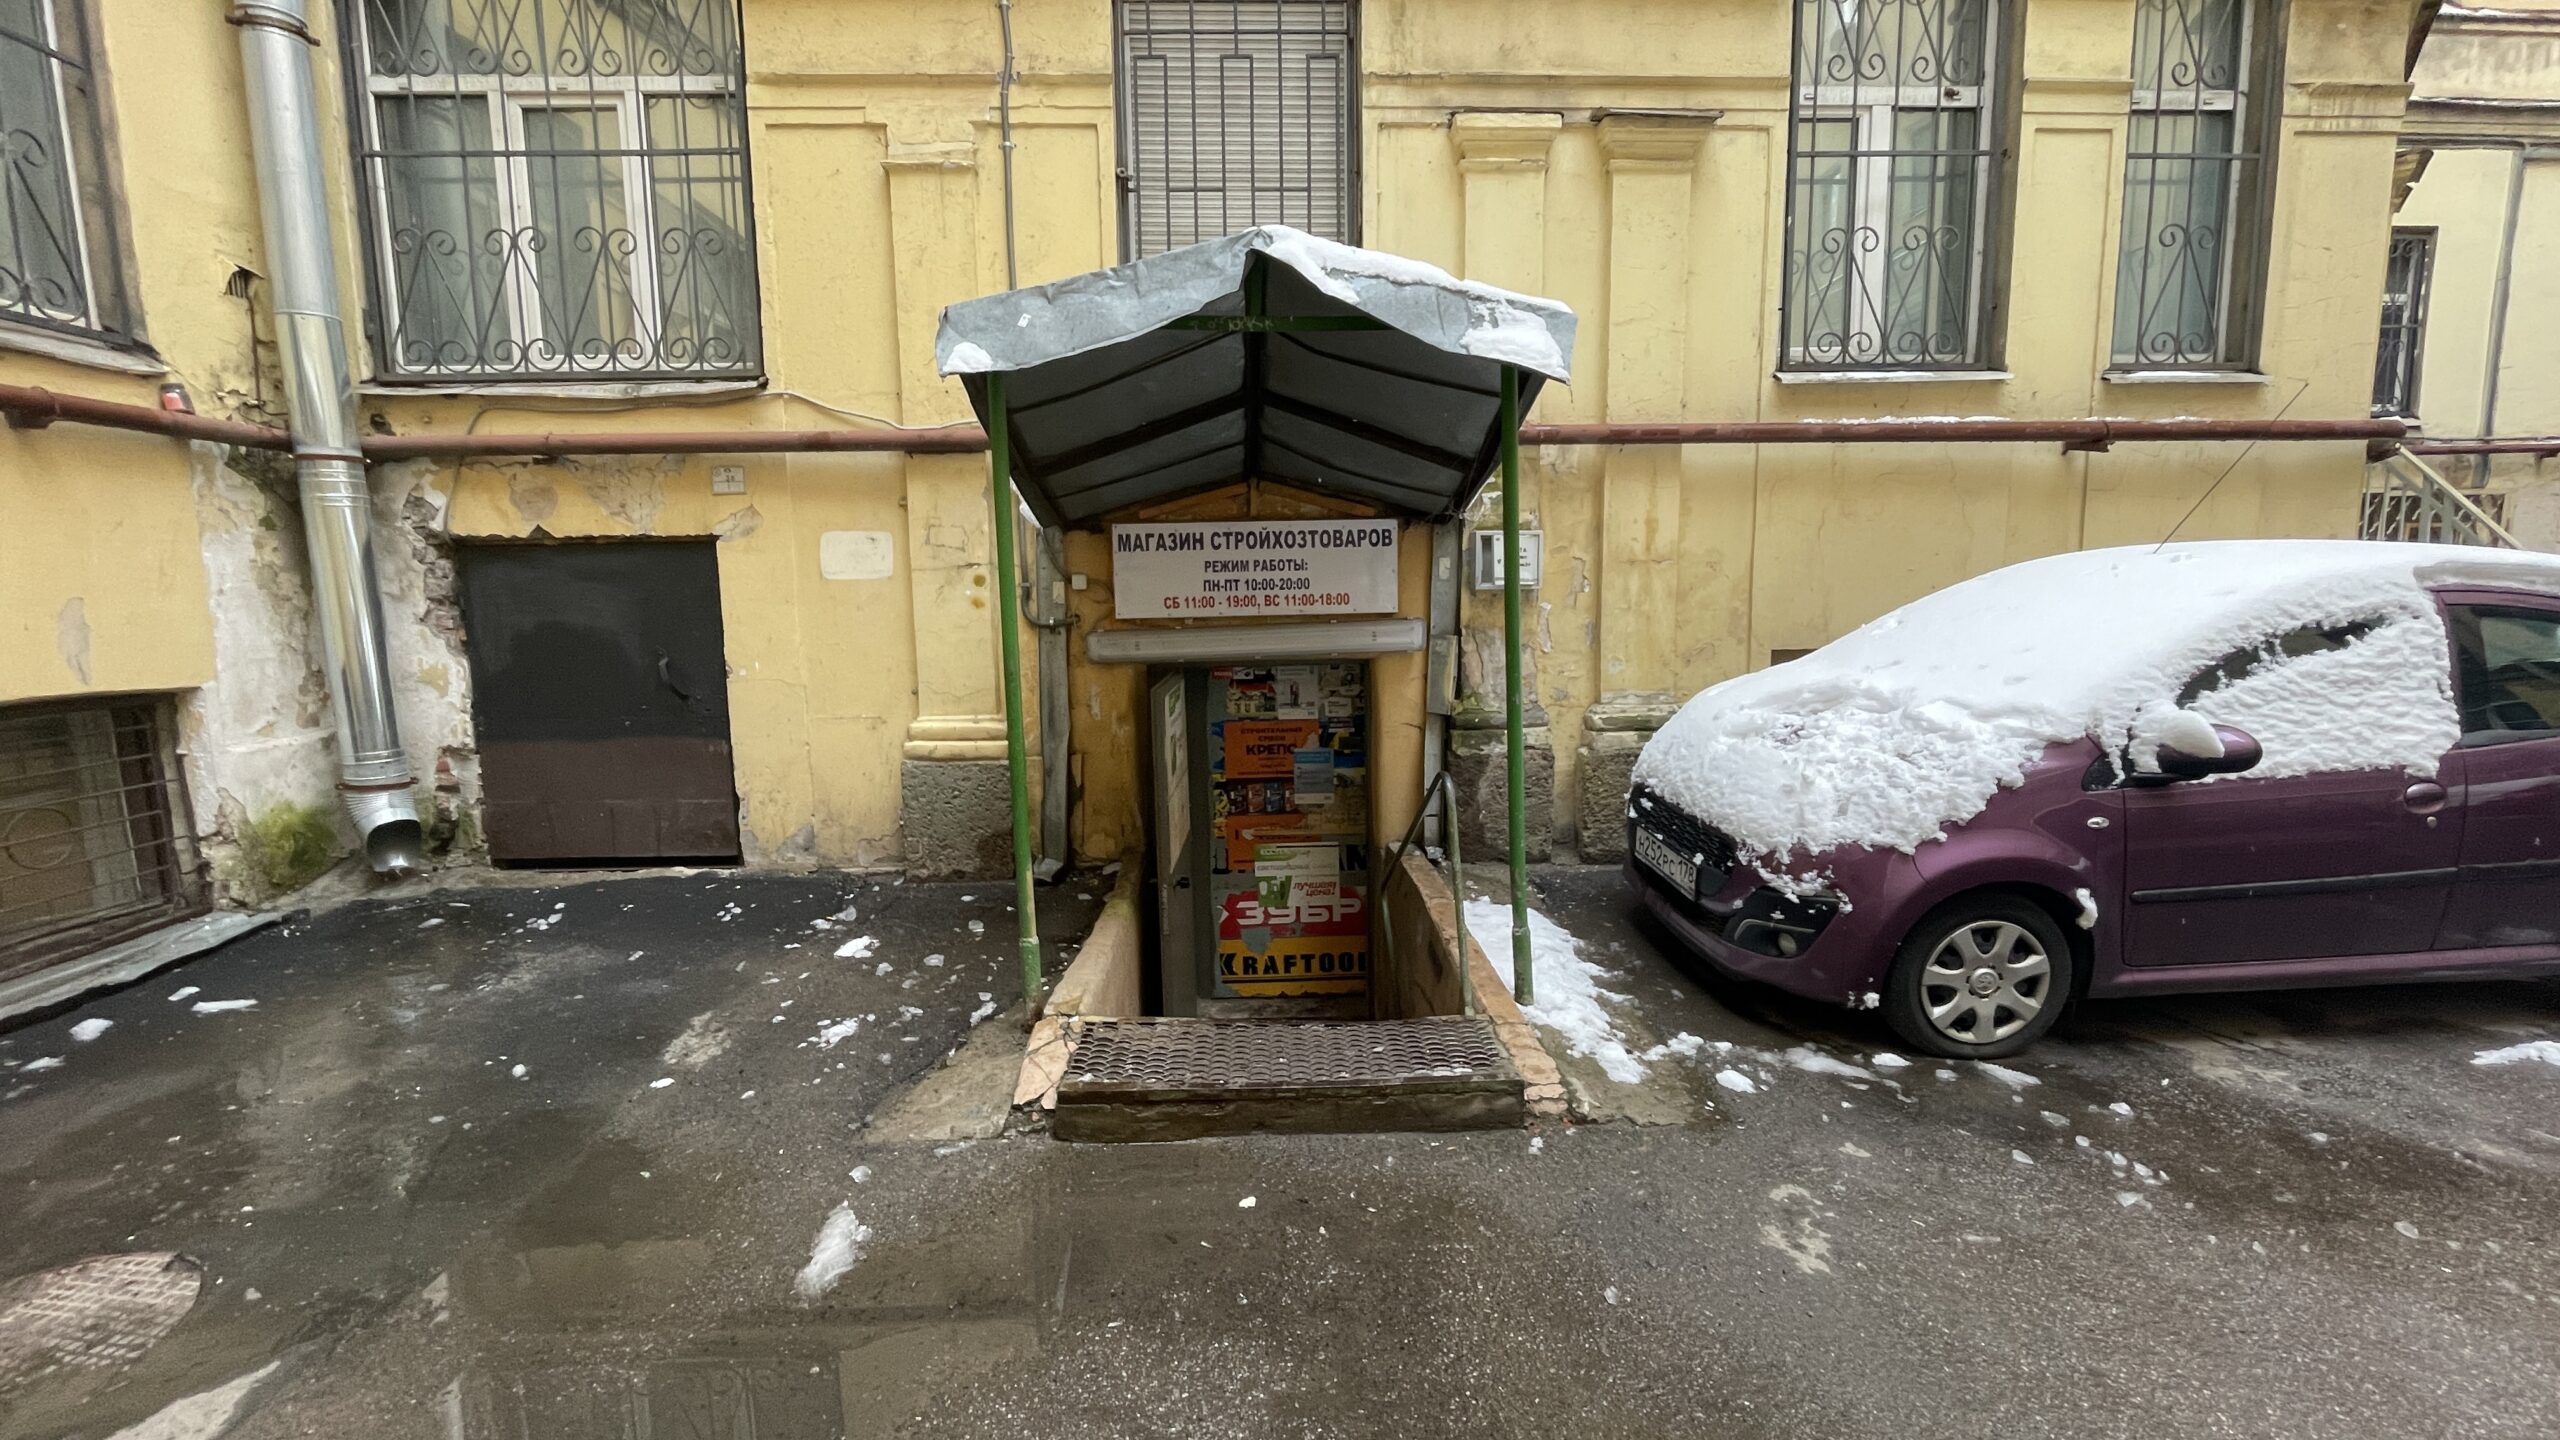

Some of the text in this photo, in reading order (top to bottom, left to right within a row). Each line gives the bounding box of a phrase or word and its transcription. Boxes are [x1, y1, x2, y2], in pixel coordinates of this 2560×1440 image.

[1116, 526, 1393, 553] МАГАЗИН СТРОЙХОЗТОВАРОВ
[1204, 558, 1308, 573] РЕЖИМ РАБОТЫ:
[1203, 578, 1310, 592] ПН-ПТ 10:00-20:00
[1164, 596, 1181, 609] СБ
[1184, 596, 1215, 609] 11:00
[1226, 594, 1261, 608] 19:00,
[1264, 594, 1280, 607] ВС
[1284, 593, 1350, 606] 11:00-18:00
[1678, 859, 1694, 884] 178
